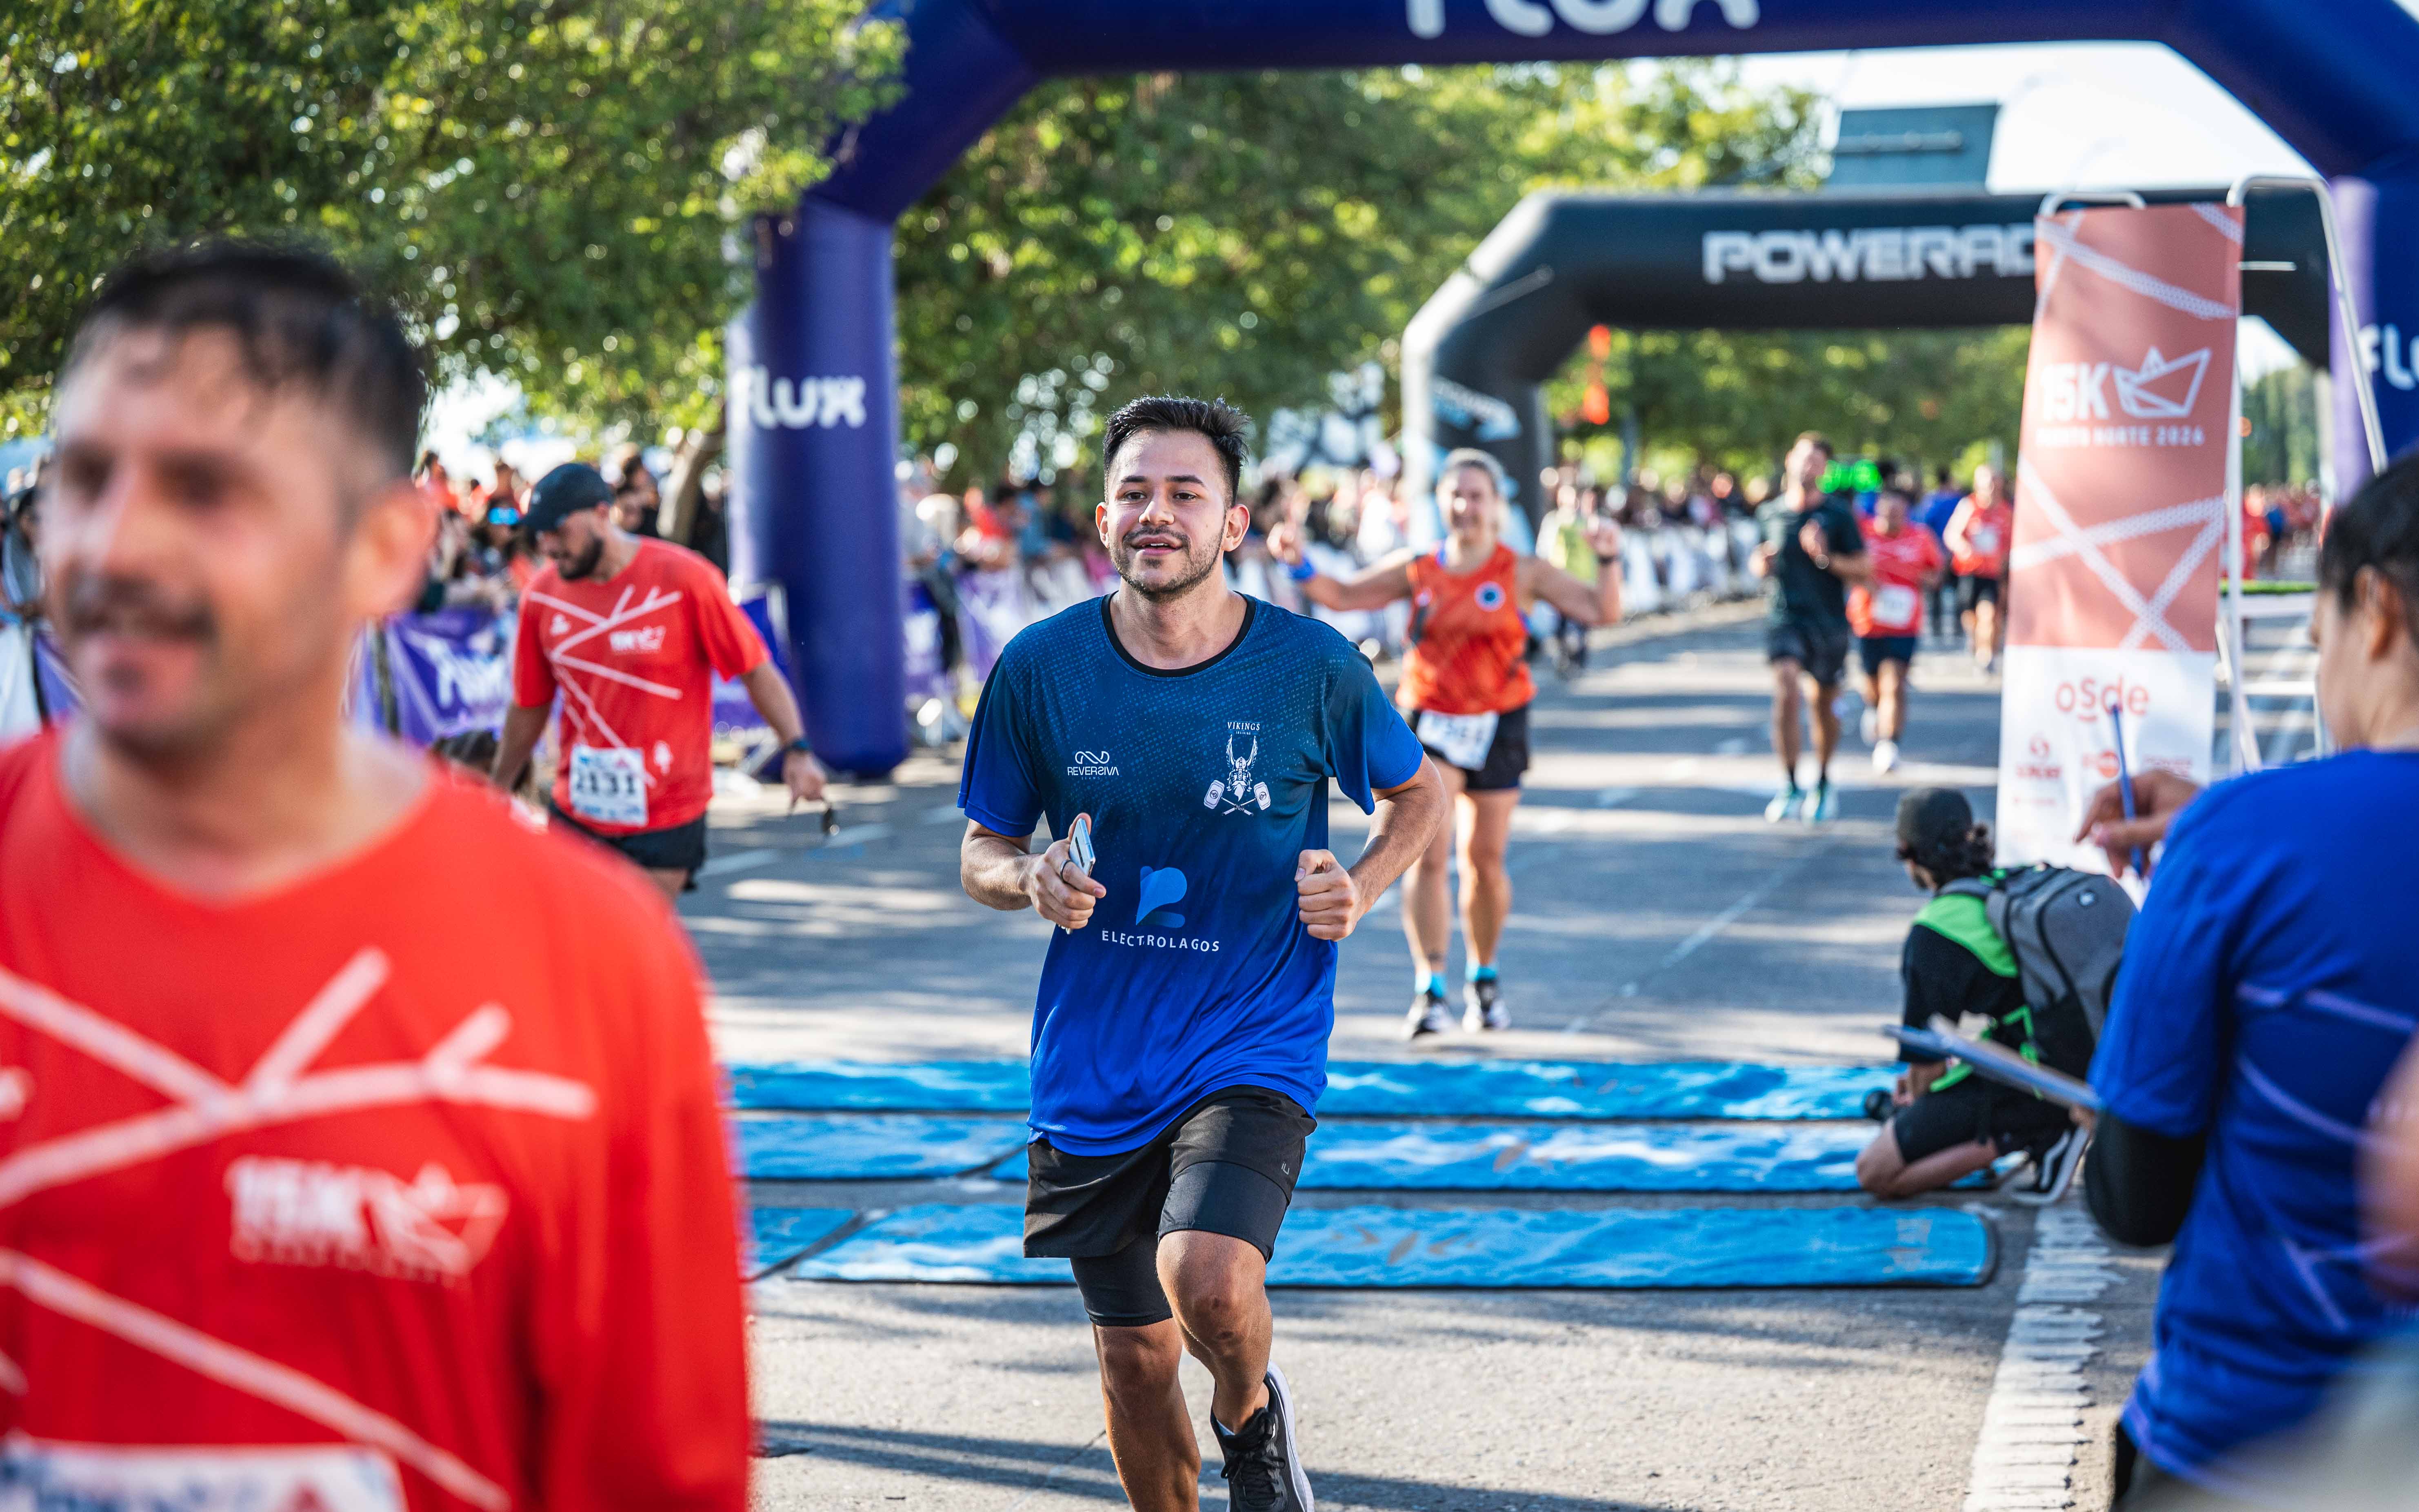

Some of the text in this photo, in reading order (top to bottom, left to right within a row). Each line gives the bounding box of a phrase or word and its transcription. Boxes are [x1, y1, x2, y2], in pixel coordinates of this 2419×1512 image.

[1227, 722, 1260, 730] VIKINGS
[1067, 766, 1119, 776] REVERSIVA
[1102, 930, 1219, 952] ELECTROLAGOS
